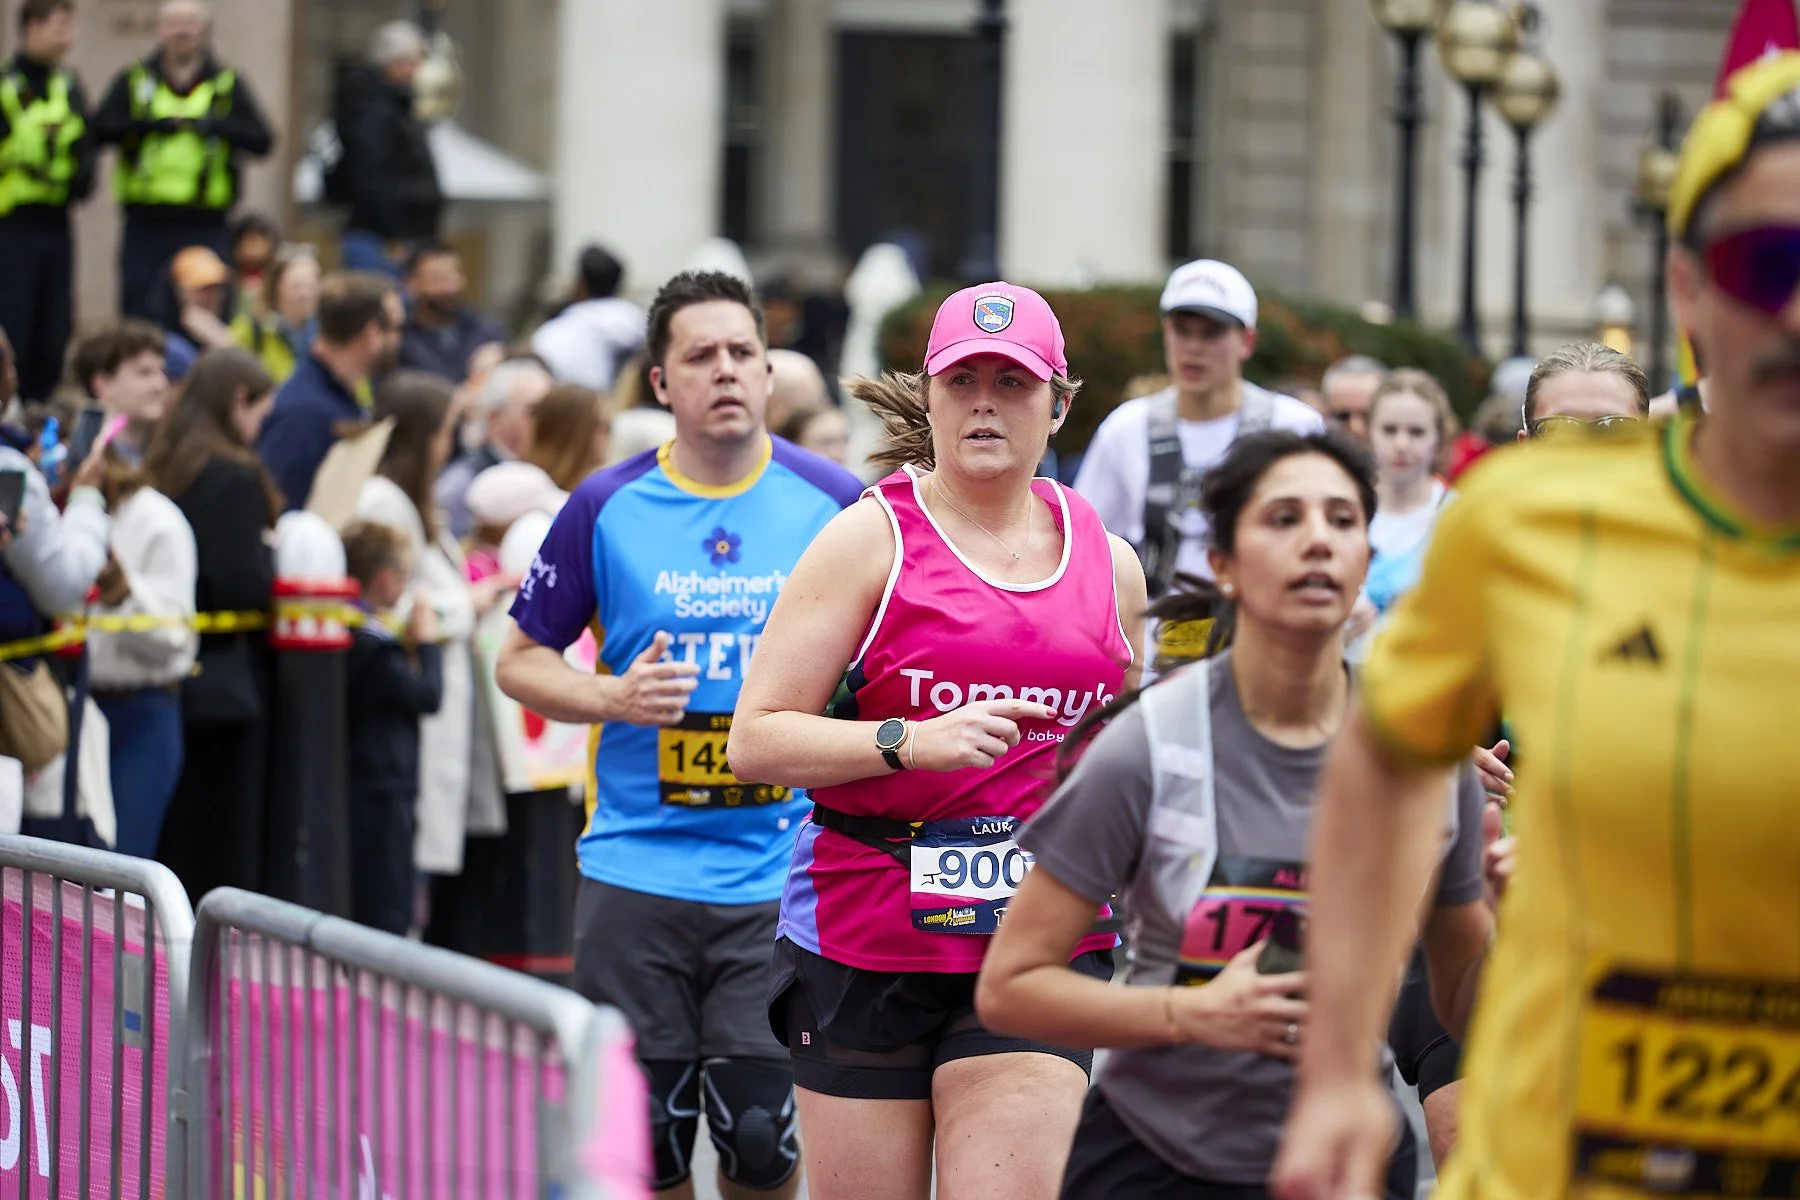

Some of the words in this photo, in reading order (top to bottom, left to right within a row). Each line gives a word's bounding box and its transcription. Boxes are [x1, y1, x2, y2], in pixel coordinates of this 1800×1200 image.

[654, 570, 786, 594] Alzheimer's
[674, 592, 767, 624] Society
[900, 668, 1115, 727] Tommy's
[1027, 728, 1065, 743] baby
[938, 848, 1026, 889] 900
[923, 915, 947, 924] LONDON
